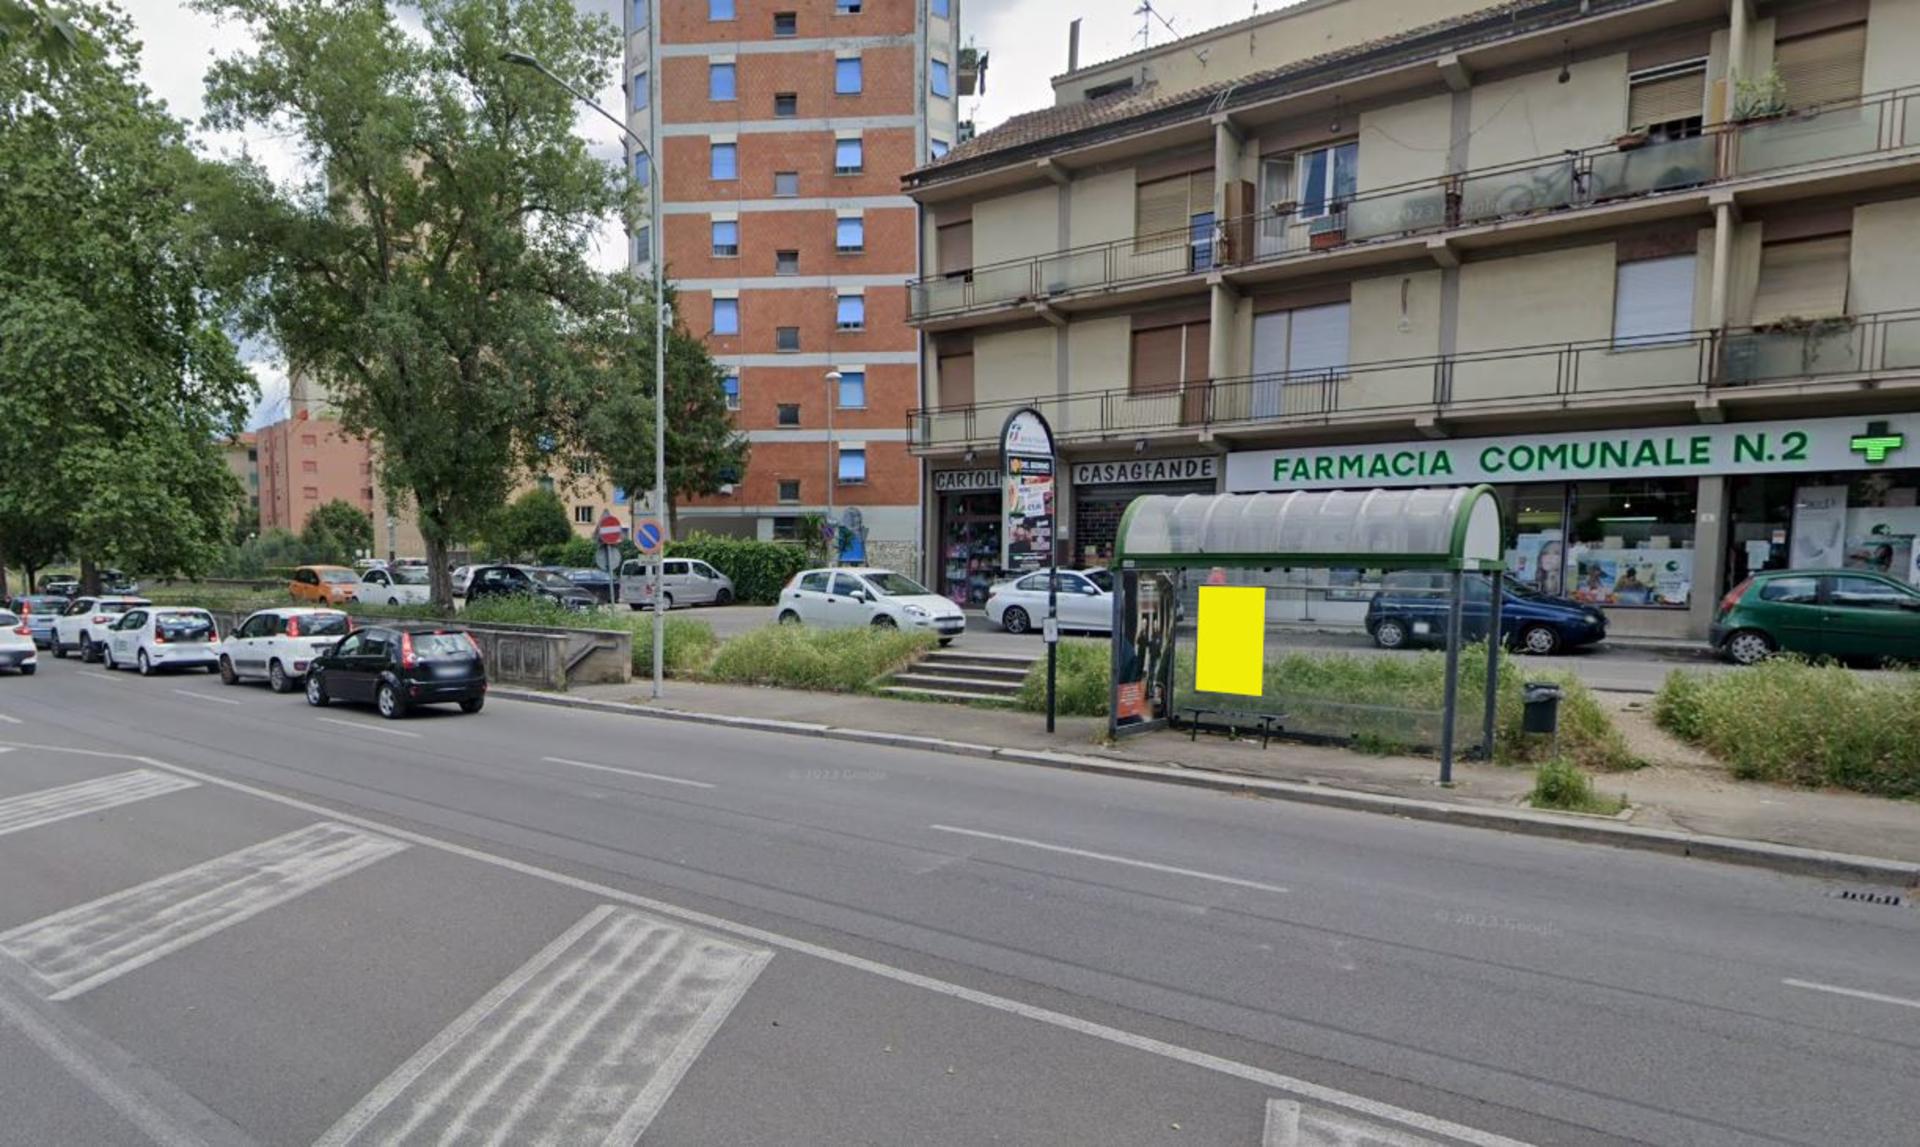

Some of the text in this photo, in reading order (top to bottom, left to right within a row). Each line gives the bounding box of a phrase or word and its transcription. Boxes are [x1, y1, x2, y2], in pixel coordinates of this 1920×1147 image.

[1273, 431, 1808, 481] FARMACIA COMUNALE N.2
